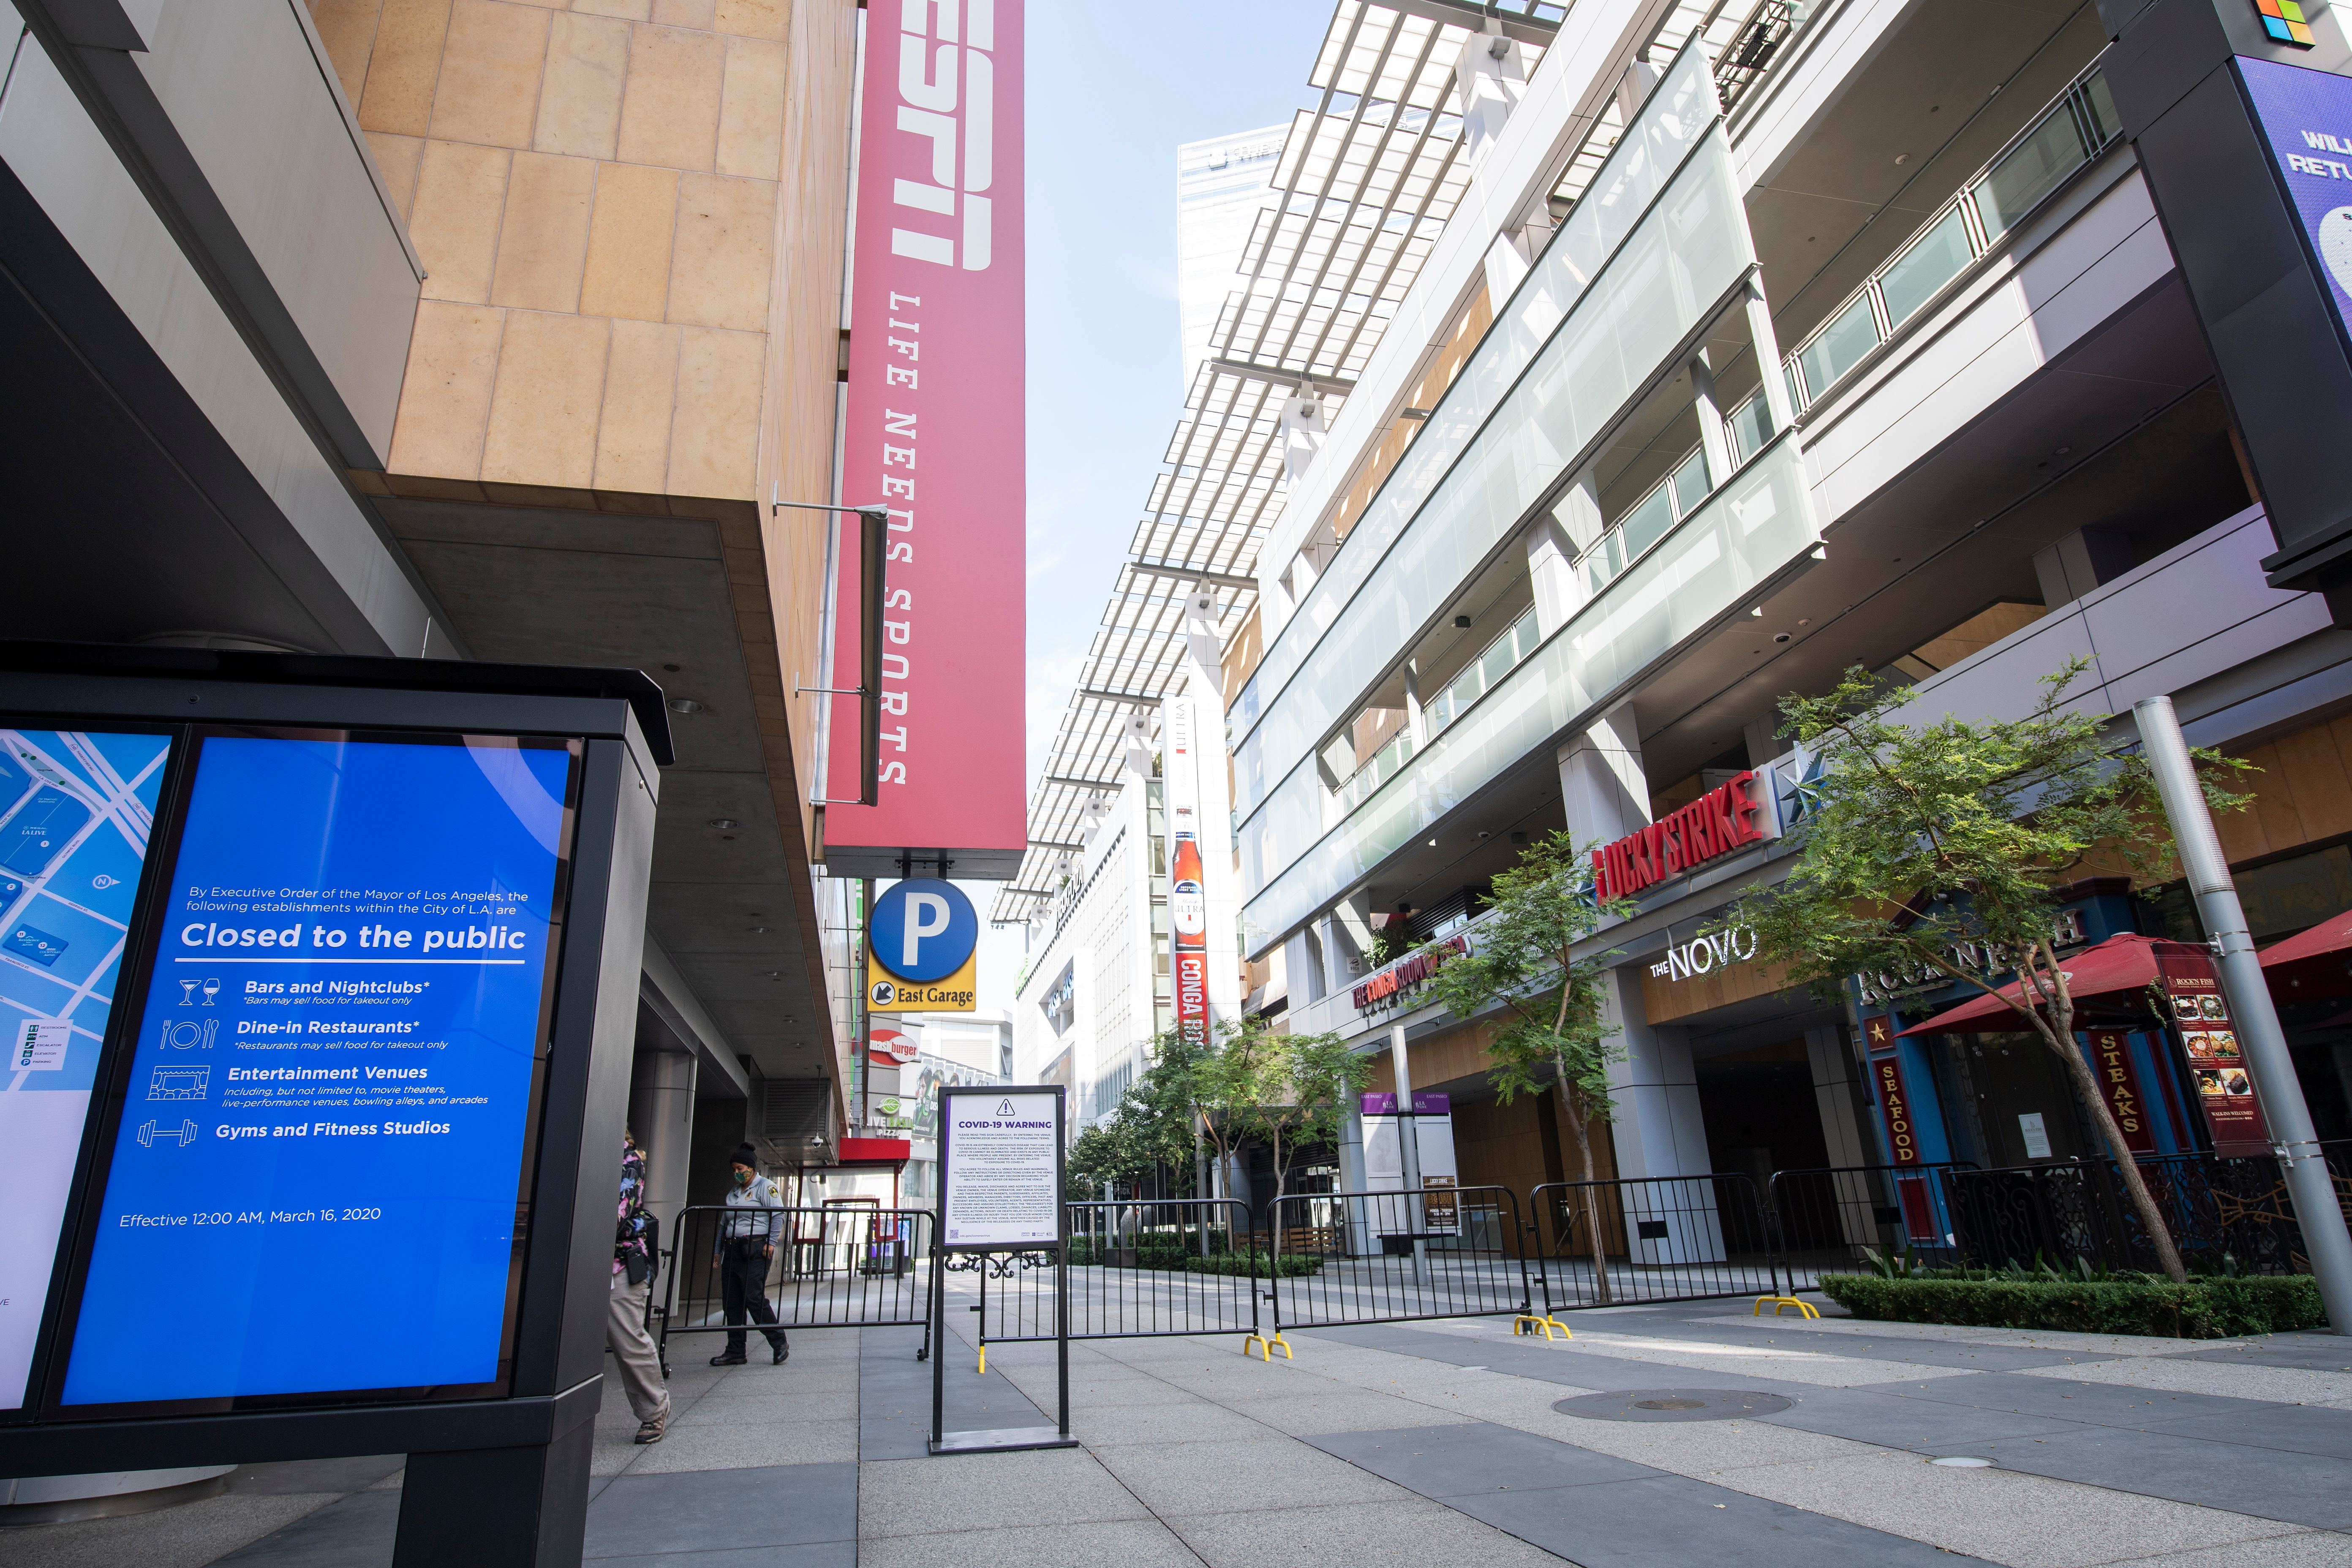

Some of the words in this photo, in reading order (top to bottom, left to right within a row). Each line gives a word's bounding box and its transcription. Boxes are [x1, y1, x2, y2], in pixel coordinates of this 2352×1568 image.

[887, 291, 920, 389] LIFE
[882, 408, 915, 563] NEEDS
[879, 587, 911, 784] SPORTS
[1176, 704, 1186, 745] ULTRA
[1592, 822, 1666, 907] LUCKY
[1662, 770, 1762, 873] STRIKE
[189, 887, 207, 898] By
[211, 887, 275, 897] Executive
[280, 888, 318, 898] Order
[322, 889, 336, 898] of
[340, 889, 360, 898] the
[365, 890, 404, 900] Mayor
[408, 890, 421, 899] of
[425, 891, 446, 899] Los
[450, 891, 504, 902] Angeles,
[508, 892, 528, 901] the
[187, 901, 248, 912] following
[252, 902, 350, 912] establishments
[356, 904, 393, 912] within
[399, 904, 418, 913] the
[423, 904, 448, 915] City
[452, 905, 466, 913] of
[469, 905, 492, 914] L.A.
[182, 923, 302, 947] Closed
[313, 926, 346, 947] to
[359, 925, 411, 947] the
[423, 926, 525, 952] public
[903, 892, 950, 966] P
[5, 957, 24, 967] FRANCISCO
[1650, 961, 1669, 978] THE
[1668, 924, 1757, 982] NOVO
[245, 981, 284, 993] Bars
[290, 981, 323, 993] and
[1181, 959, 1203, 1014] CONGA
[1351, 984, 1368, 1009] THE
[1367, 970, 1397, 1002] CONGA
[1395, 956, 1426, 989] ROOM
[392, 997, 412, 1005] only
[898, 988, 923, 1002] East
[927, 988, 973, 1006] Garage
[237, 1021, 302, 1033] Dine-in
[427, 1041, 449, 1049] only
[870, 1040, 917, 1056] mashburger
[228, 1067, 358, 1080] Entertainment
[365, 1067, 427, 1078] Venues
[224, 1088, 273, 1096] Including,
[2101, 1036, 2139, 1132] STEAKS
[222, 1099, 310, 1108] live-performance
[353, 1097, 393, 1106] bowling
[395, 1097, 425, 1105] alleys,
[867, 1116, 886, 1127] IVE
[888, 1117, 915, 1128] BASIL
[1883, 1067, 1914, 1161] SEAFOOD
[216, 1125, 267, 1140] Gyms
[273, 1123, 308, 1137] and
[313, 1123, 377, 1135] Fitness
[383, 1121, 450, 1134] Studios
[120, 1214, 187, 1227] Effective
[193, 1212, 232, 1225] 12:00
[236, 1211, 264, 1224] AM,
[270, 1210, 315, 1222] March
[320, 1209, 337, 1222] 16,
[342, 1208, 381, 1220] 2020
